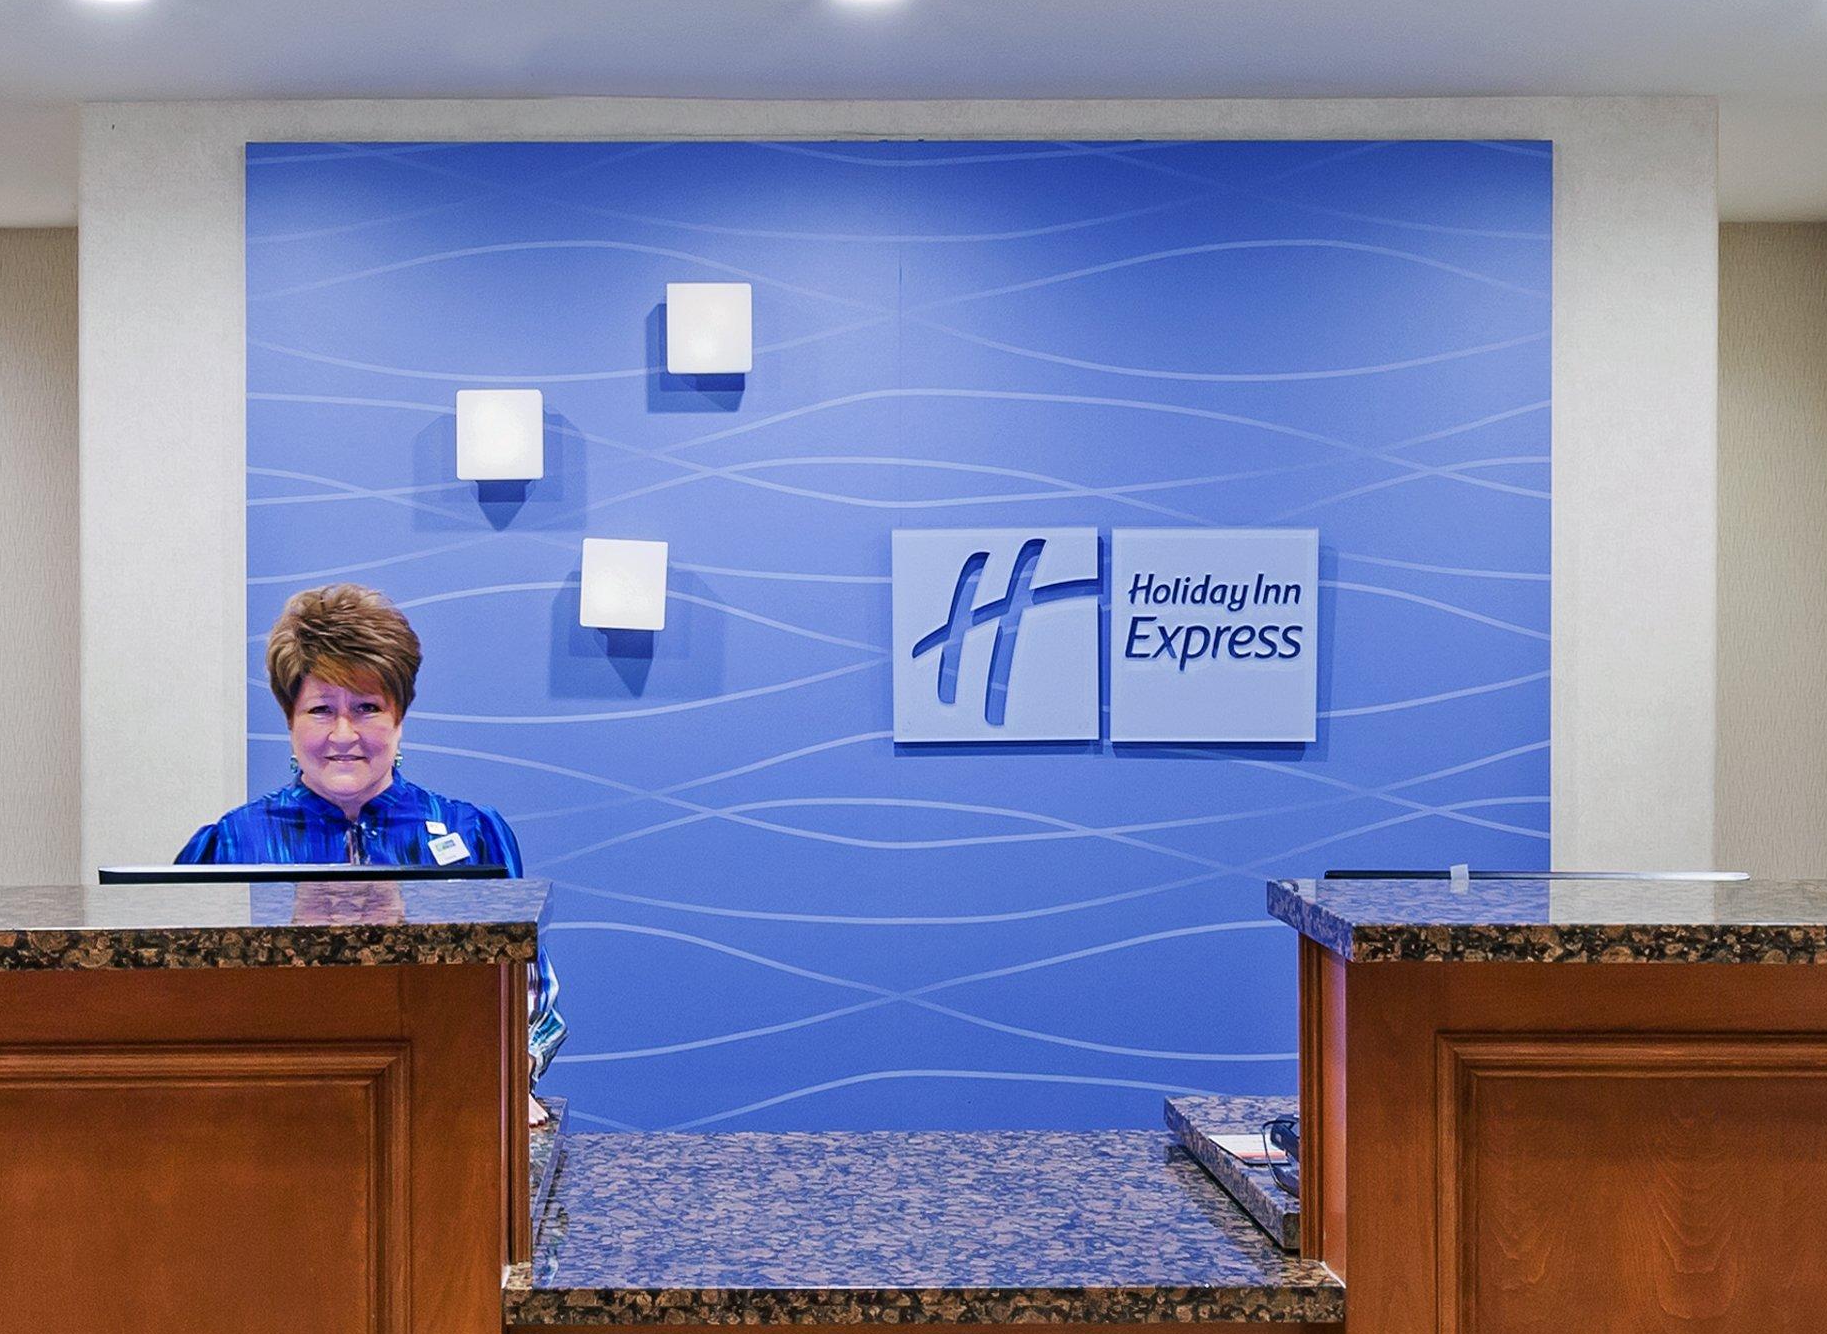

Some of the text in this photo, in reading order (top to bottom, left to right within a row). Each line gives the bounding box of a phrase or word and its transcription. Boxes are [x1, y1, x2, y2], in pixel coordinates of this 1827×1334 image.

[1127, 573, 1301, 612] Holiday Inn
[1124, 616, 1304, 672] Express
